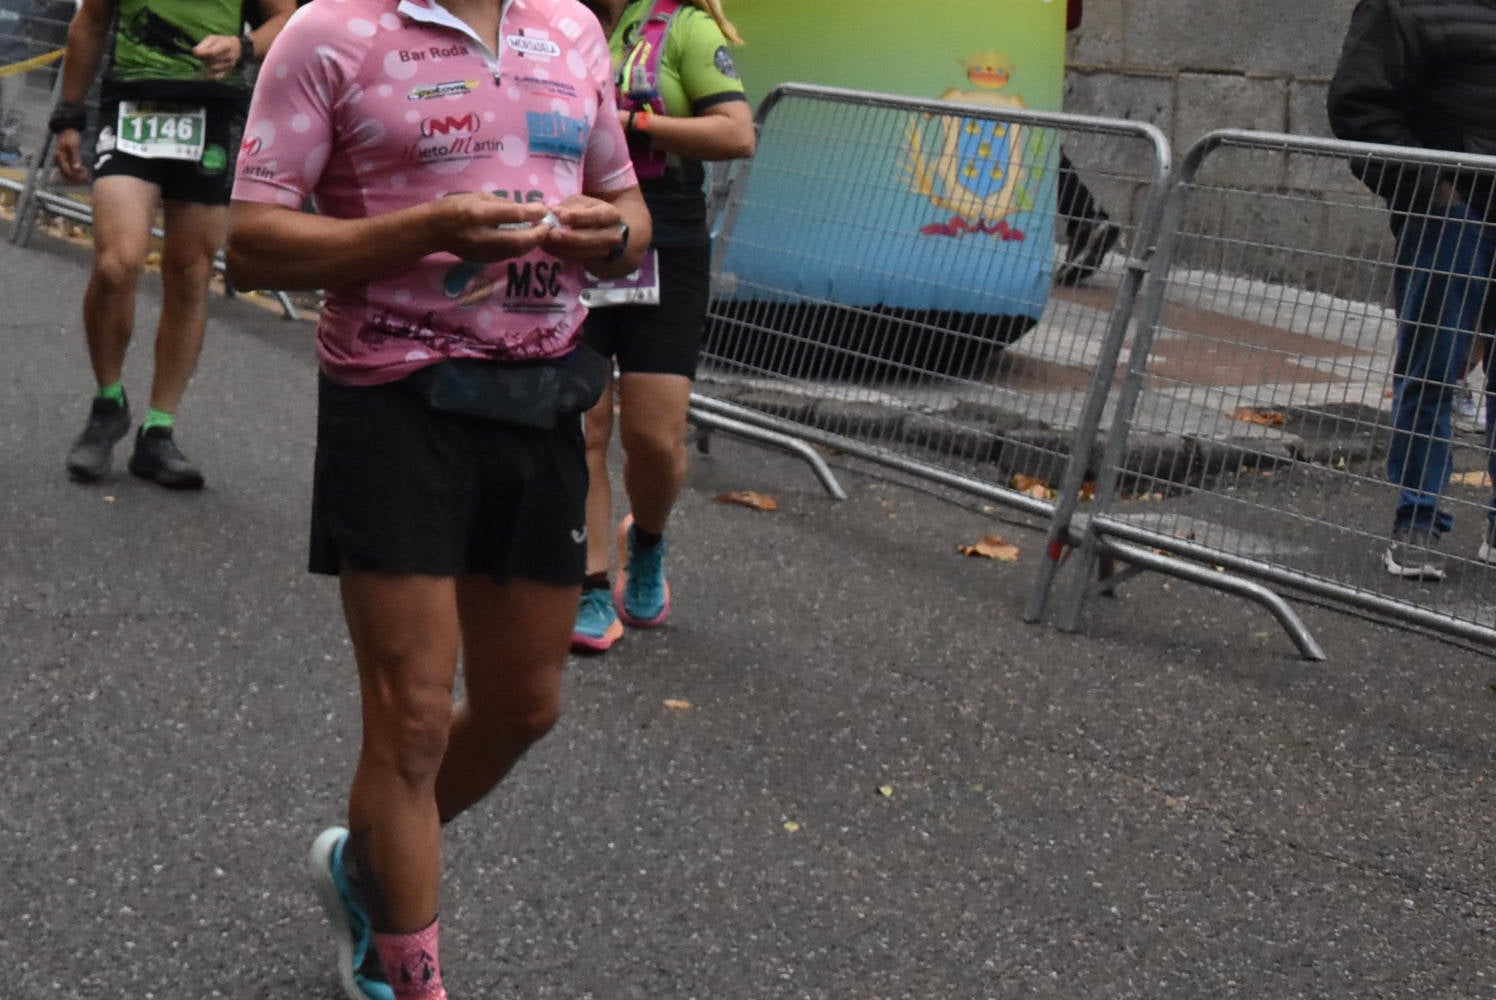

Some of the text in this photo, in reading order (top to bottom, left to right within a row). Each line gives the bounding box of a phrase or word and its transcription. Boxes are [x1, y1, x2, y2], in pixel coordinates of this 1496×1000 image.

[398, 44, 470, 63] Bar Roda
[130, 115, 194, 141] 1146
[505, 261, 562, 299] MSC
